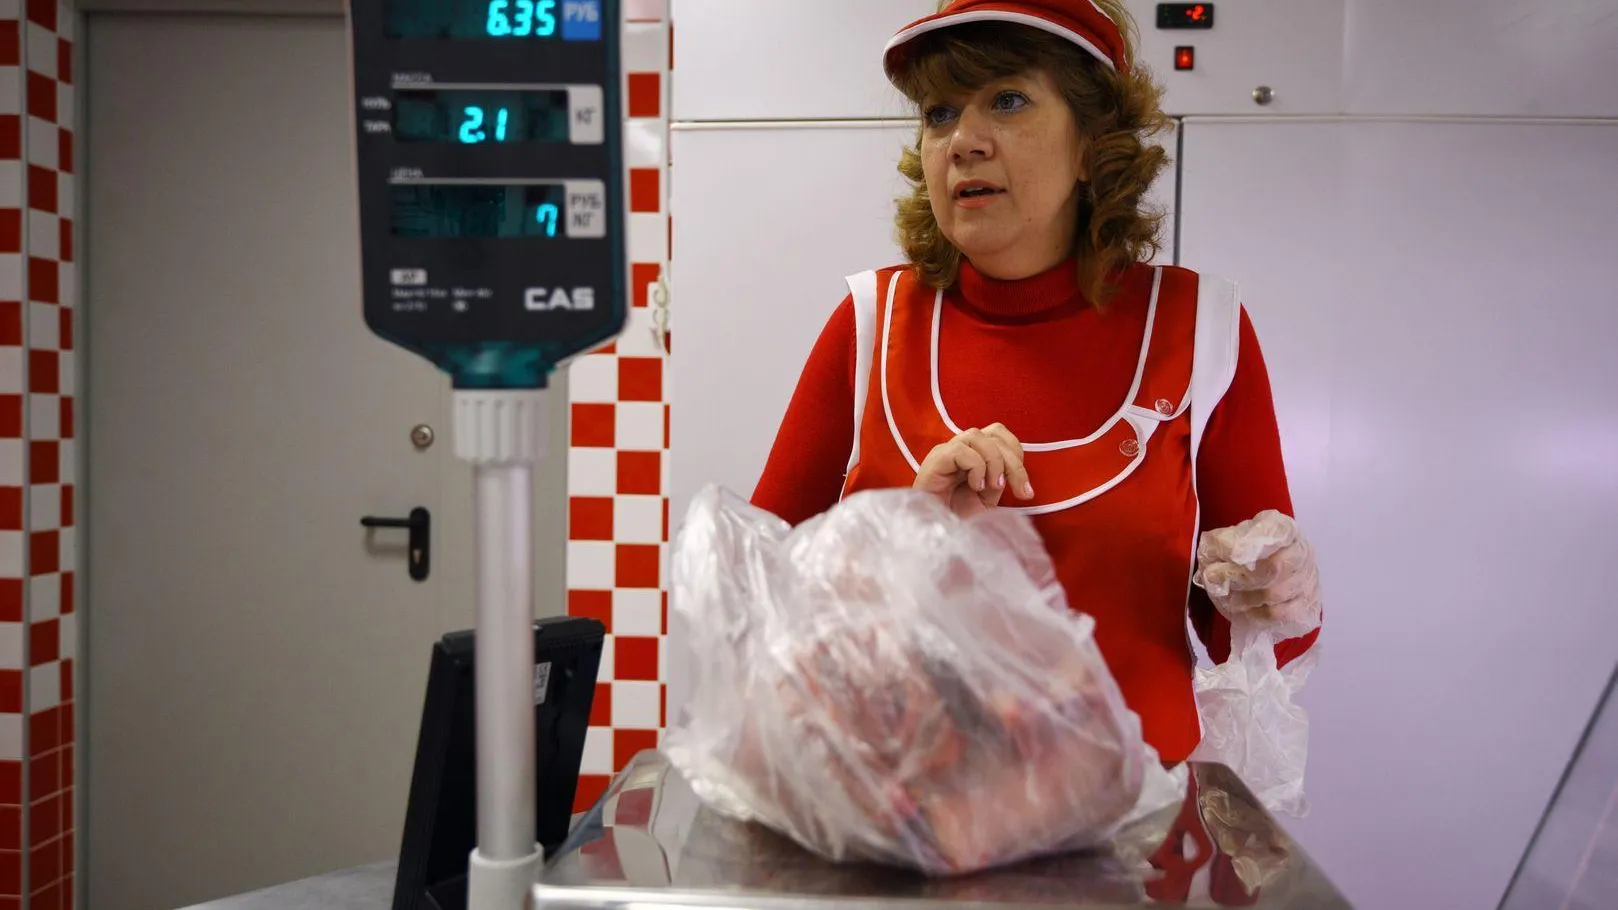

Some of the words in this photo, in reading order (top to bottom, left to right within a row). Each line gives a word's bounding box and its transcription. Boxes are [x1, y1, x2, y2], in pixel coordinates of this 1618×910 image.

[486, 0, 555, 36] 6.35
[564, 2, 599, 22] РУБ
[459, 106, 508, 143] 2.1
[576, 106, 596, 125] КГ
[536, 204, 558, 237] 7
[524, 287, 594, 310] CAS
